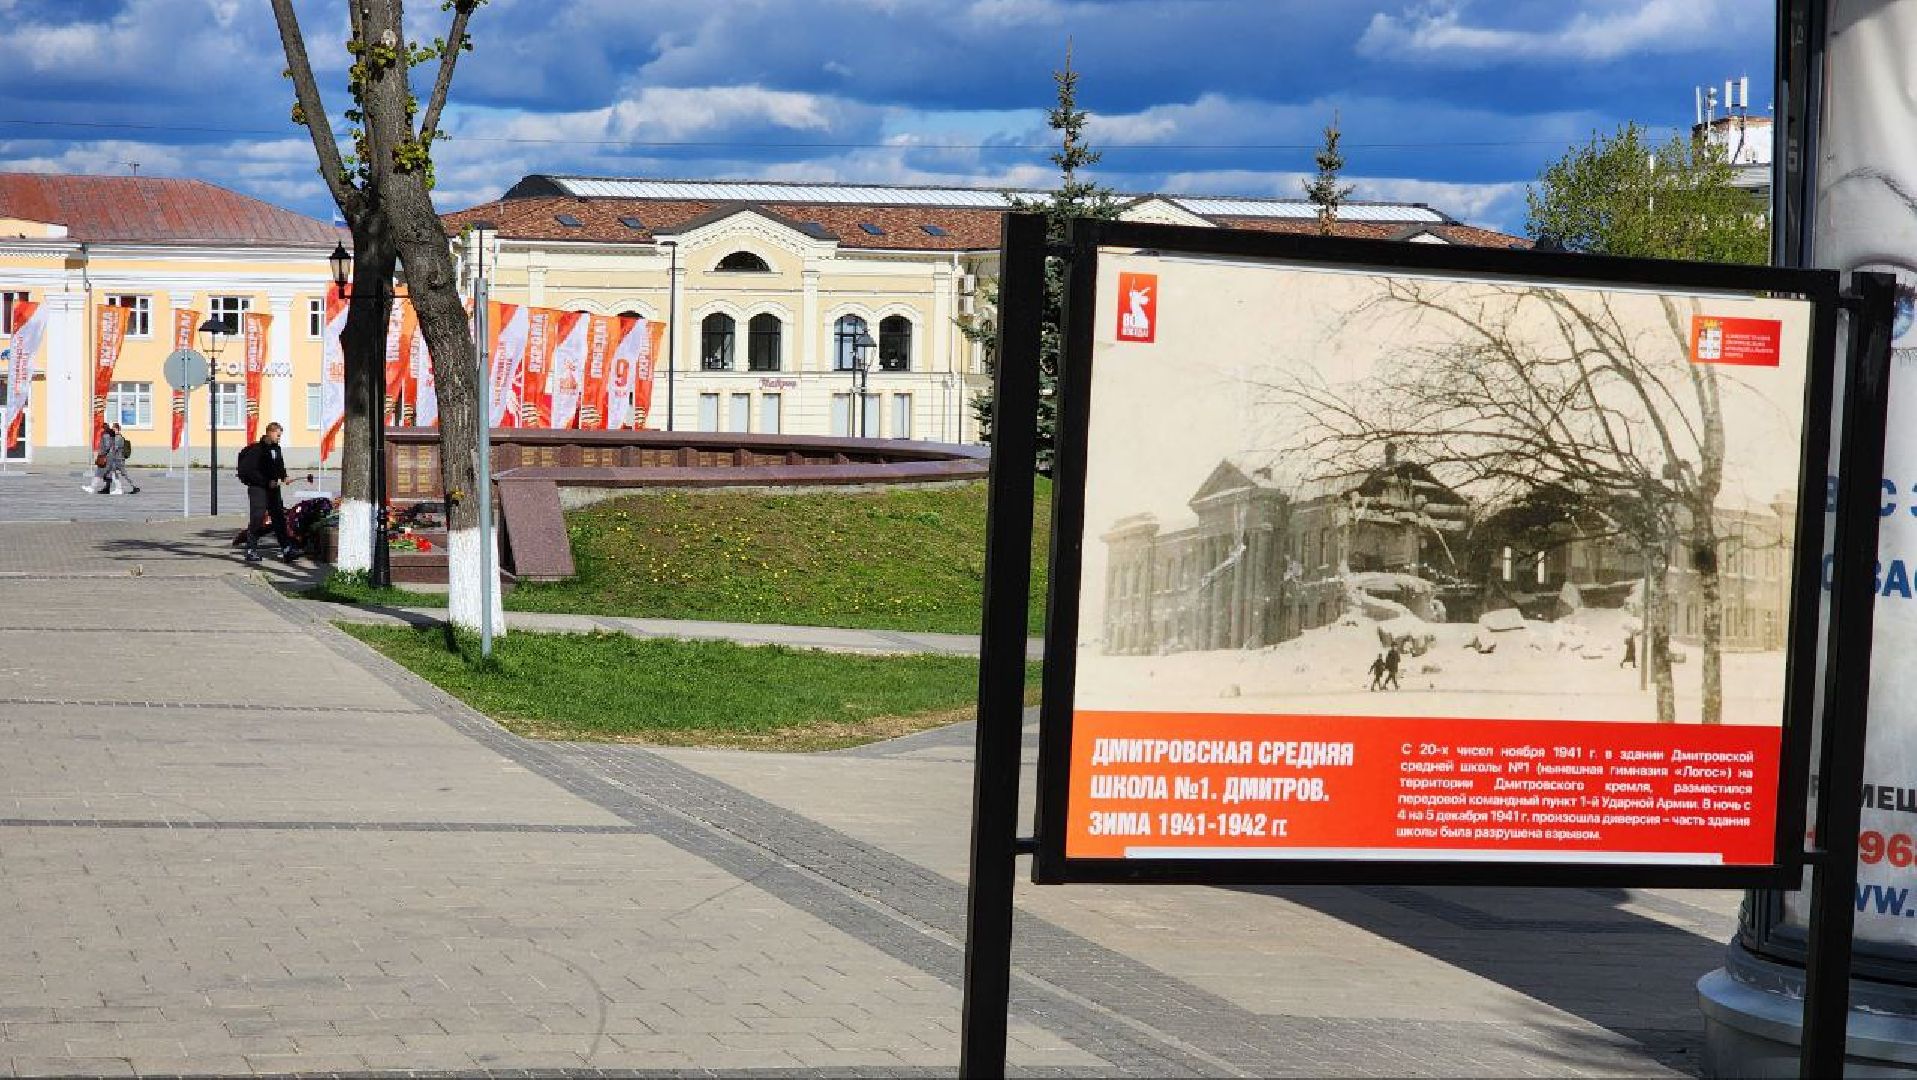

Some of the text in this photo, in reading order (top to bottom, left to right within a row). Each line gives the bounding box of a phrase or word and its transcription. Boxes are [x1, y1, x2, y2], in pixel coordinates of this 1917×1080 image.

[1091, 738, 1354, 768] ДМИТРОВСКАЯ СРЕДНЯЯ
[1401, 743, 1412, 755] С
[1419, 743, 1448, 756] 20-х
[1457, 747, 1493, 756] чисел
[1500, 745, 1545, 759] ноября
[1553, 747, 1581, 758] 1941
[1605, 750, 1612, 759] в
[1620, 751, 1664, 760] здании
[1671, 749, 1754, 763] Дмитровской
[1401, 760, 1455, 773] средней
[1460, 763, 1502, 772] школы
[1508, 762, 1529, 772] №1
[1610, 766, 1668, 776] гимназия
[1738, 769, 1754, 778] на
[1090, 775, 1329, 804] ШКОЛА №1. ДМИТРОВ.
[1400, 778, 1473, 790] территории
[1494, 778, 1584, 792] Дмитровского
[1673, 783, 1753, 795] разместился
[1398, 792, 1467, 806] передовой
[1469, 795, 1539, 807] командный
[1542, 797, 1577, 808] пункт
[1580, 796, 1599, 807] 1-й
[1602, 796, 1654, 810] Ударной
[1702, 798, 1711, 809] В
[1713, 801, 1741, 810] ночь
[1744, 802, 1750, 810] с
[1088, 811, 1150, 836] ЗИМА
[1159, 812, 1267, 836] 1941-1942
[1397, 808, 1406, 820] 4
[1409, 811, 1424, 820] на
[1426, 809, 1434, 820] 5
[1436, 810, 1488, 823] декабря
[1491, 810, 1518, 822] 1941
[1532, 813, 1600, 826] произошла
[1602, 814, 1660, 825] диверсия
[1672, 816, 1705, 825] часть
[1708, 815, 1750, 828] здания
[1396, 827, 1438, 838] школы
[1440, 825, 1472, 838] была
[1474, 829, 1543, 840] разрушена
